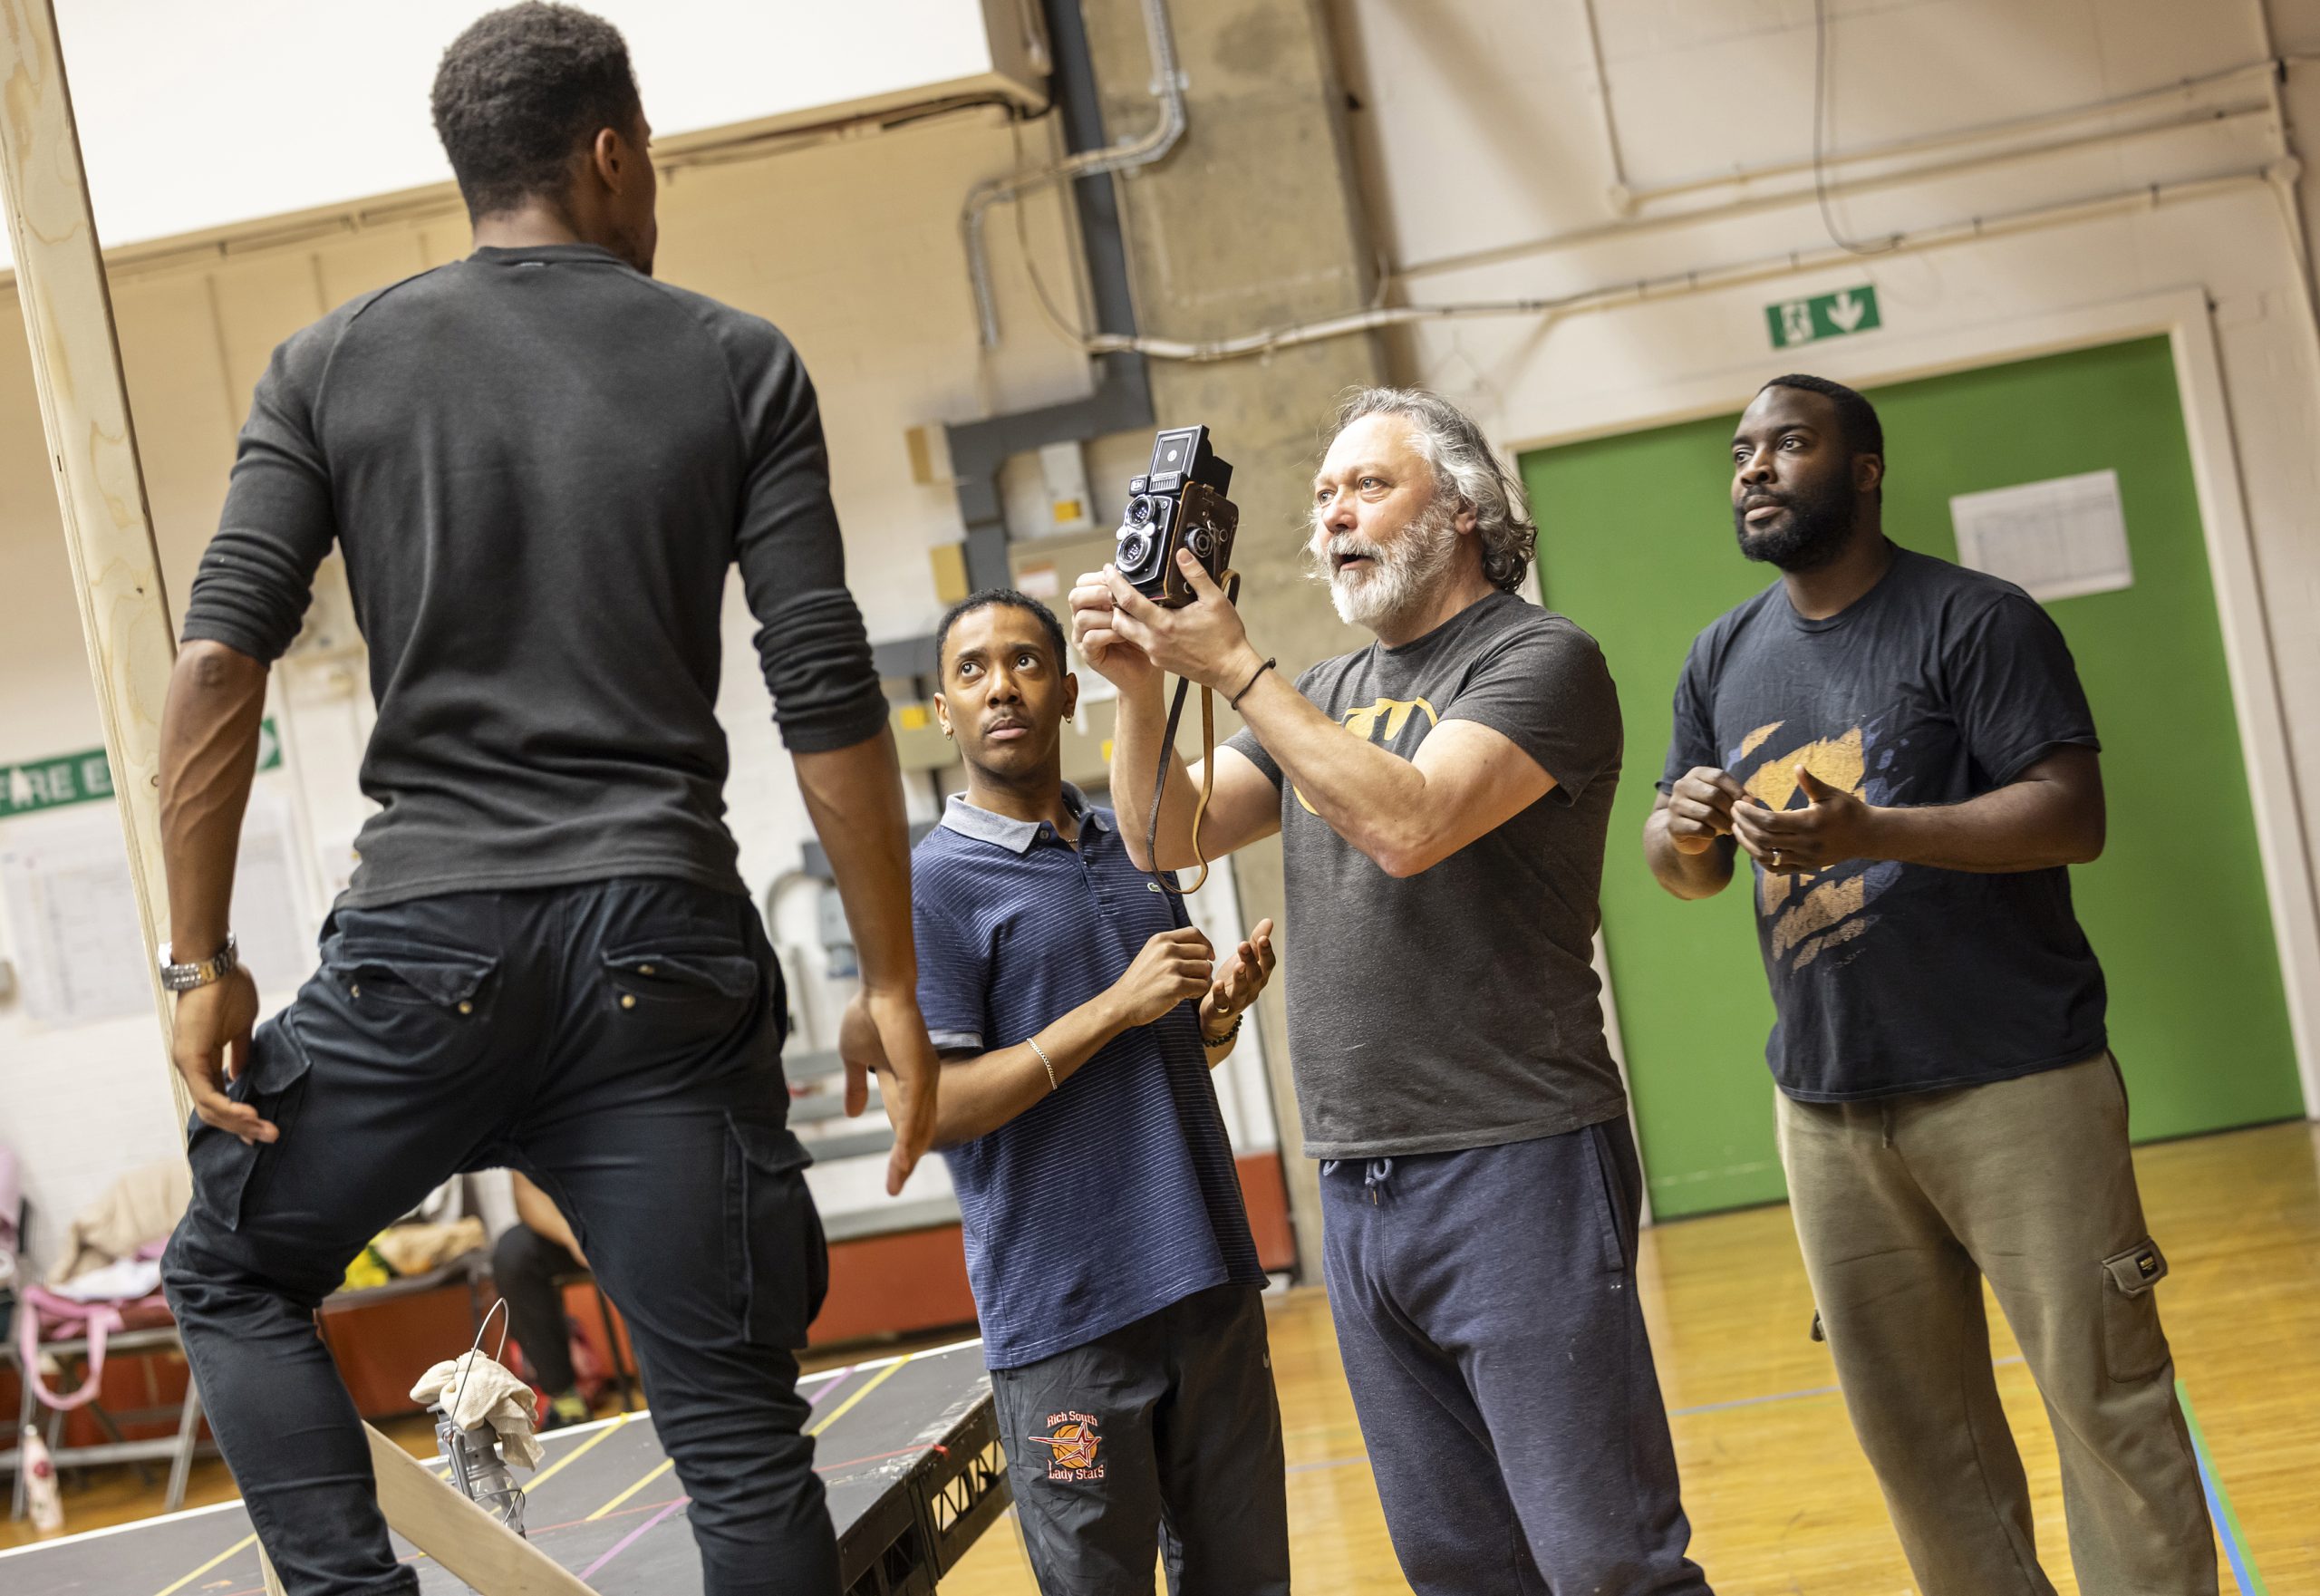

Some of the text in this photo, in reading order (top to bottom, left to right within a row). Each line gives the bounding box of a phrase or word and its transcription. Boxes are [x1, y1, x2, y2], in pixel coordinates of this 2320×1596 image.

[1047, 1410, 1097, 1427] Rich South
[1047, 1459, 1105, 1482] Lady Stars
